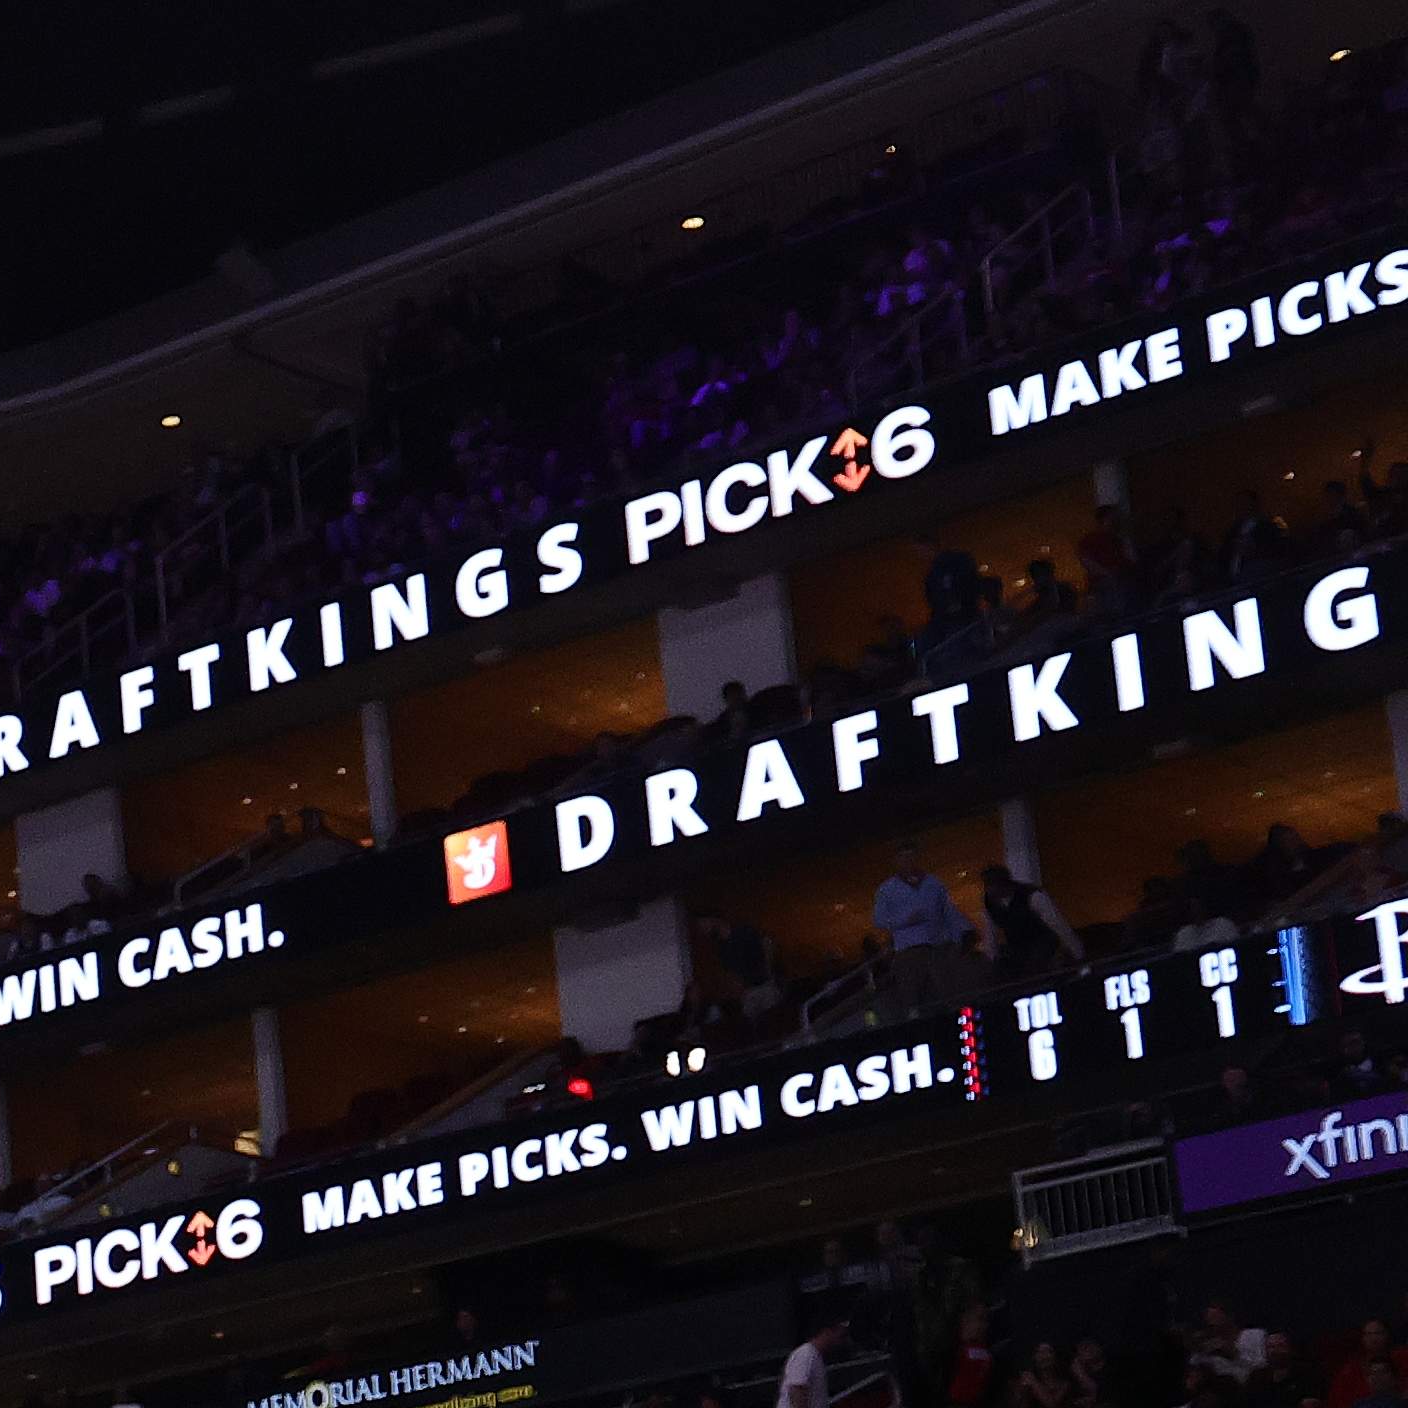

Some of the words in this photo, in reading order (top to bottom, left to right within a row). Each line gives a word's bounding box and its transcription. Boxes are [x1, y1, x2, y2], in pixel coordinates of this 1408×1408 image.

[989, 328, 1182, 434] MAKE
[1207, 250, 1408, 362] PICKS
[556, 567, 1379, 871] DRAFTKING
[118, 903, 284, 988] CASH.
[1013, 991, 1063, 1032] TOL
[1104, 969, 1151, 1010] FLS
[1199, 948, 1238, 988] CC
[1028, 1030, 1057, 1081] 6
[1121, 1009, 1143, 1059] 1
[1212, 987, 1236, 1038] 1
[302, 1162, 444, 1234] MAKE
[458, 1123, 627, 1196] PICKS.
[640, 1085, 762, 1152] WIN
[780, 1043, 955, 1118] CASH.
[390, 1342, 538, 1396] HERMANN
